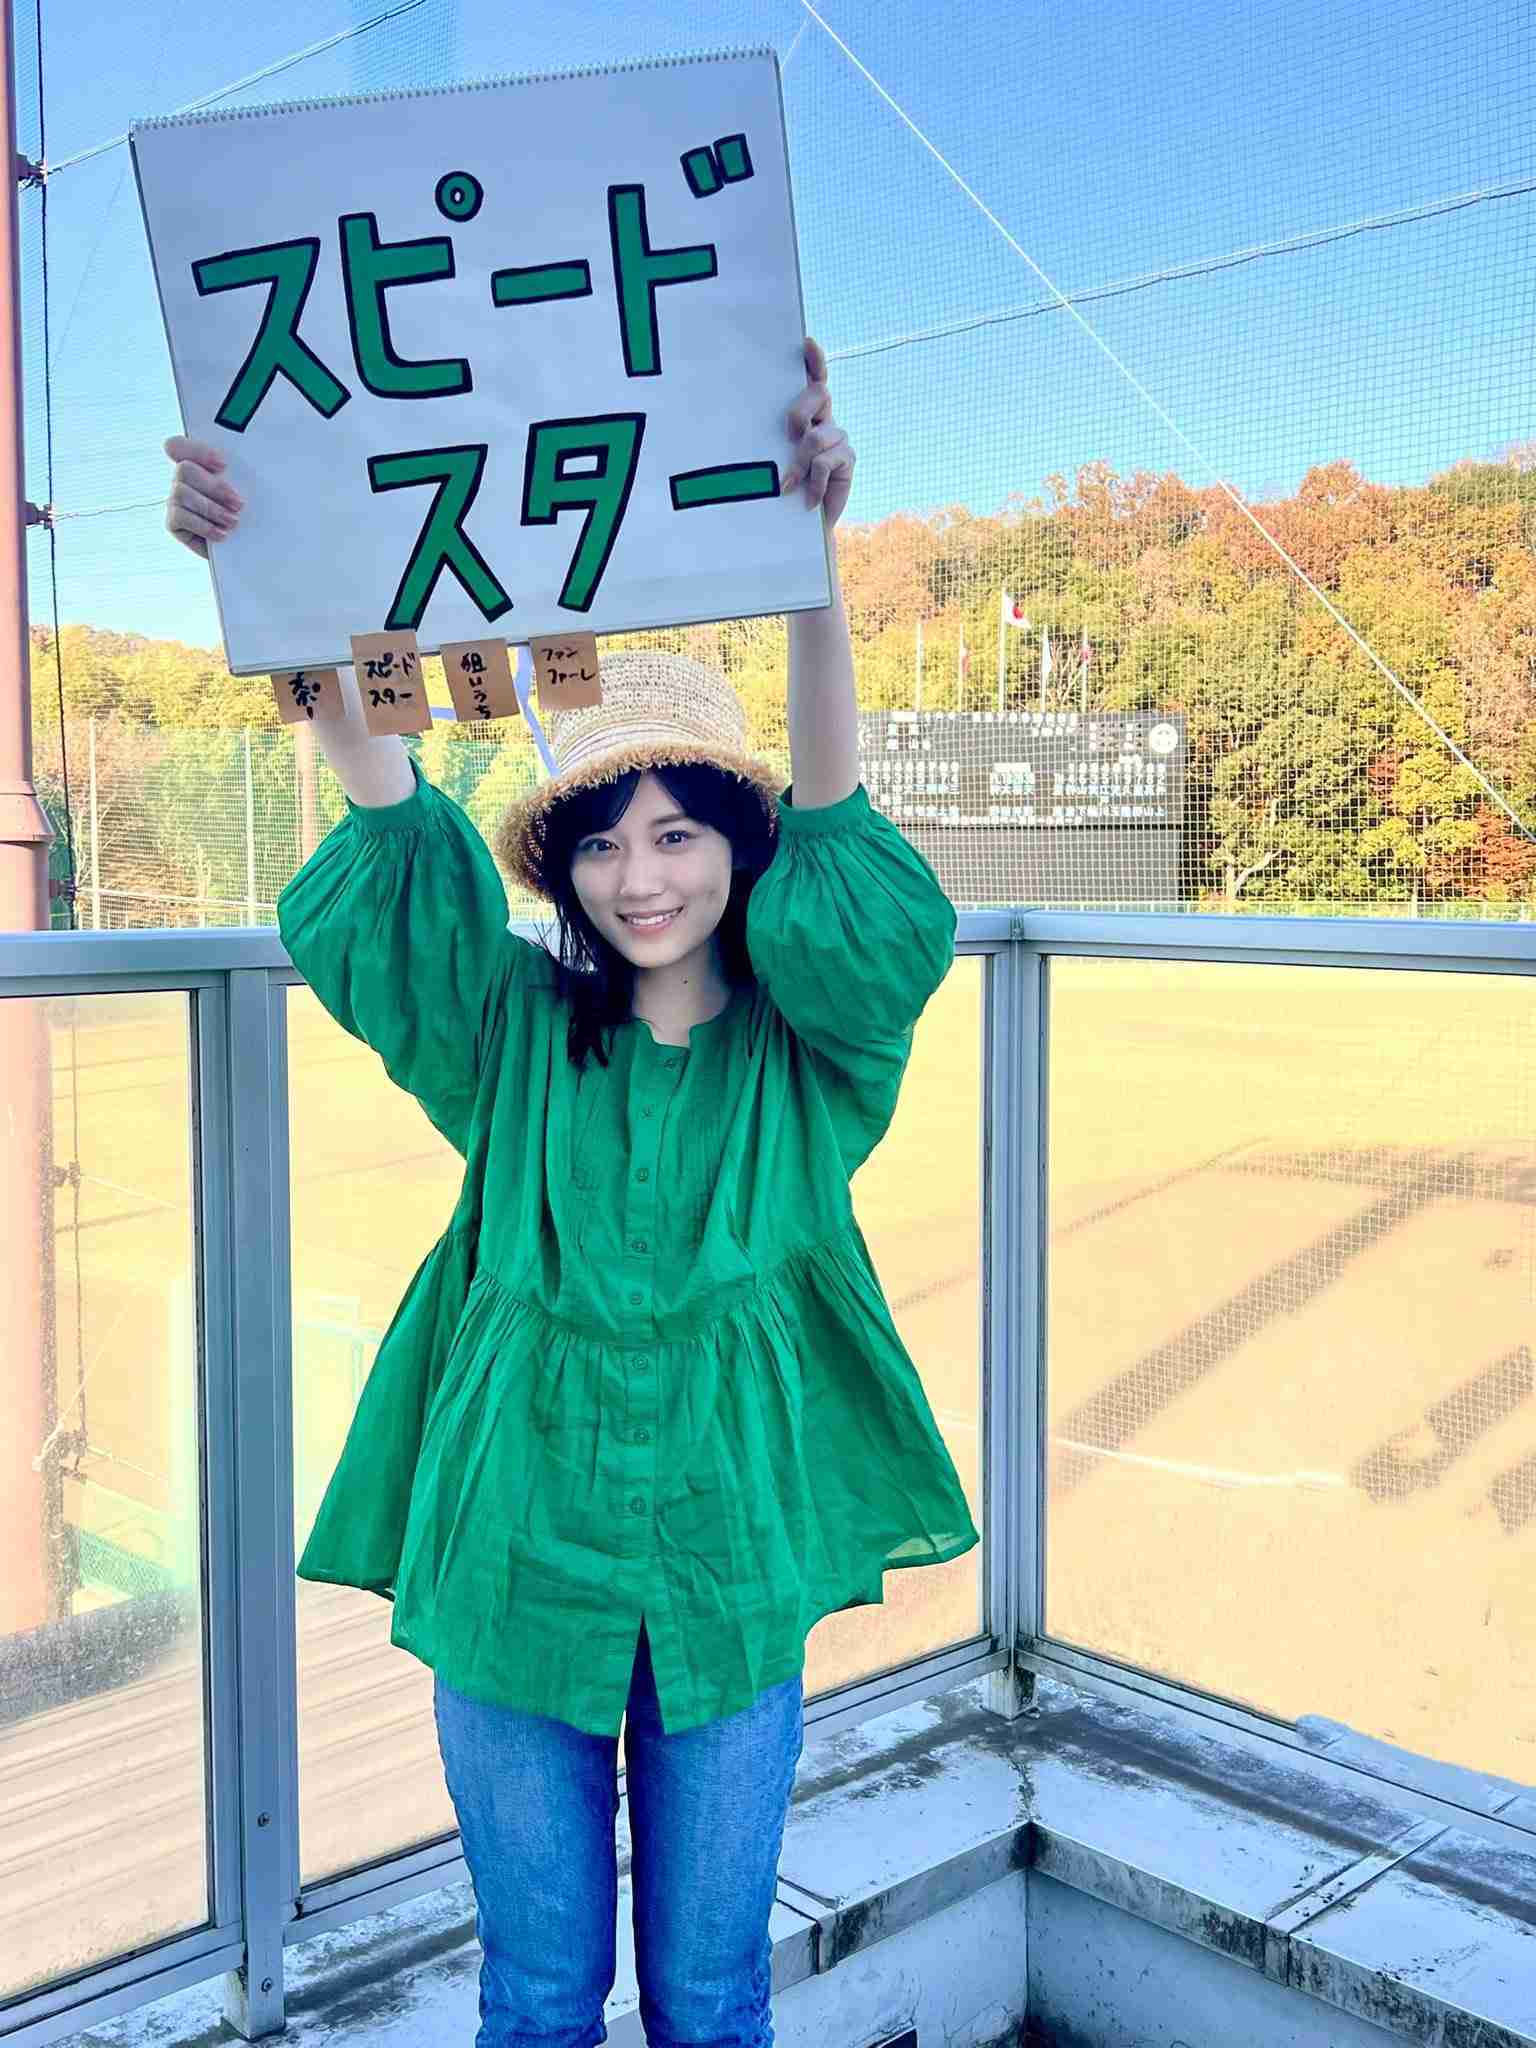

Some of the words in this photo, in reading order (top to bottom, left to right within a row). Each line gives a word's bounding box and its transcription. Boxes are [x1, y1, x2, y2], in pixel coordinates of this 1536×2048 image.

[191, 133, 754, 433] スピード
[367, 412, 780, 630] スター
[363, 652, 416, 679] スピード
[460, 652, 491, 720] 狙いうち
[547, 668, 596, 684] ファーレ
[367, 687, 413, 709] スター
